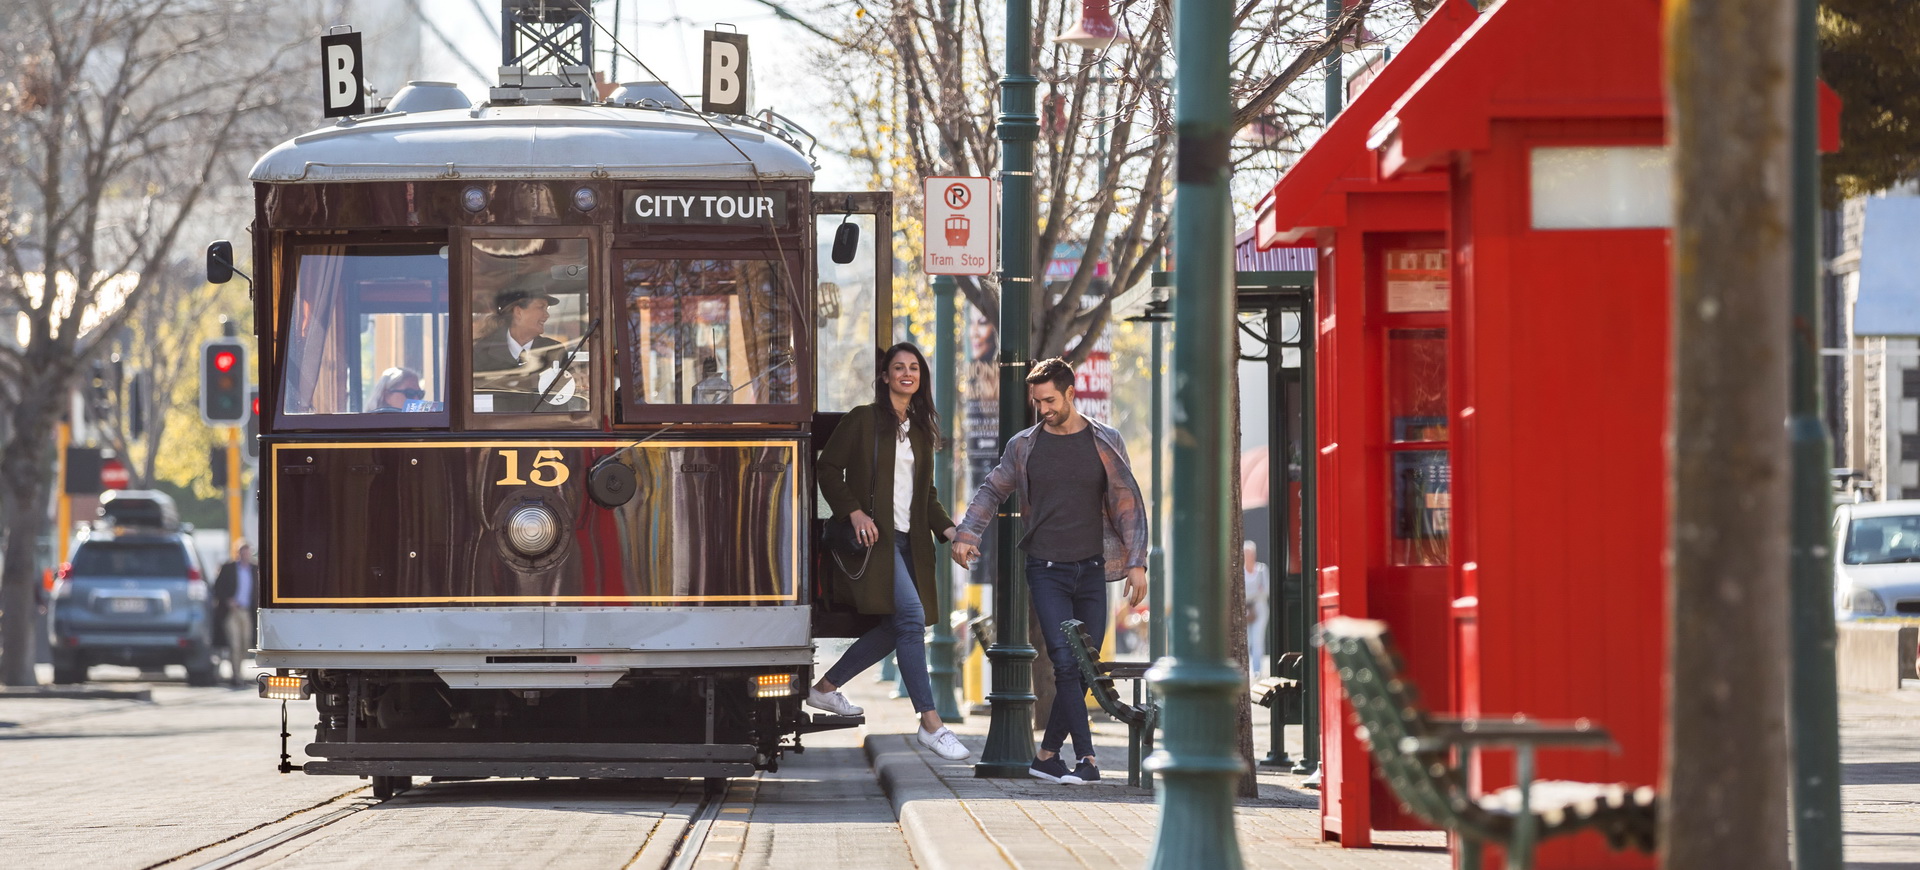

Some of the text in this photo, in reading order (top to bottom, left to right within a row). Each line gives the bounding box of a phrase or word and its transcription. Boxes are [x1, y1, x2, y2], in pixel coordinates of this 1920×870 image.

[327, 44, 357, 109] B
[709, 40, 740, 105] B
[635, 195, 774, 218] CITY TOUR
[930, 253, 985, 268] Tram Stop
[496, 449, 570, 487] 15
